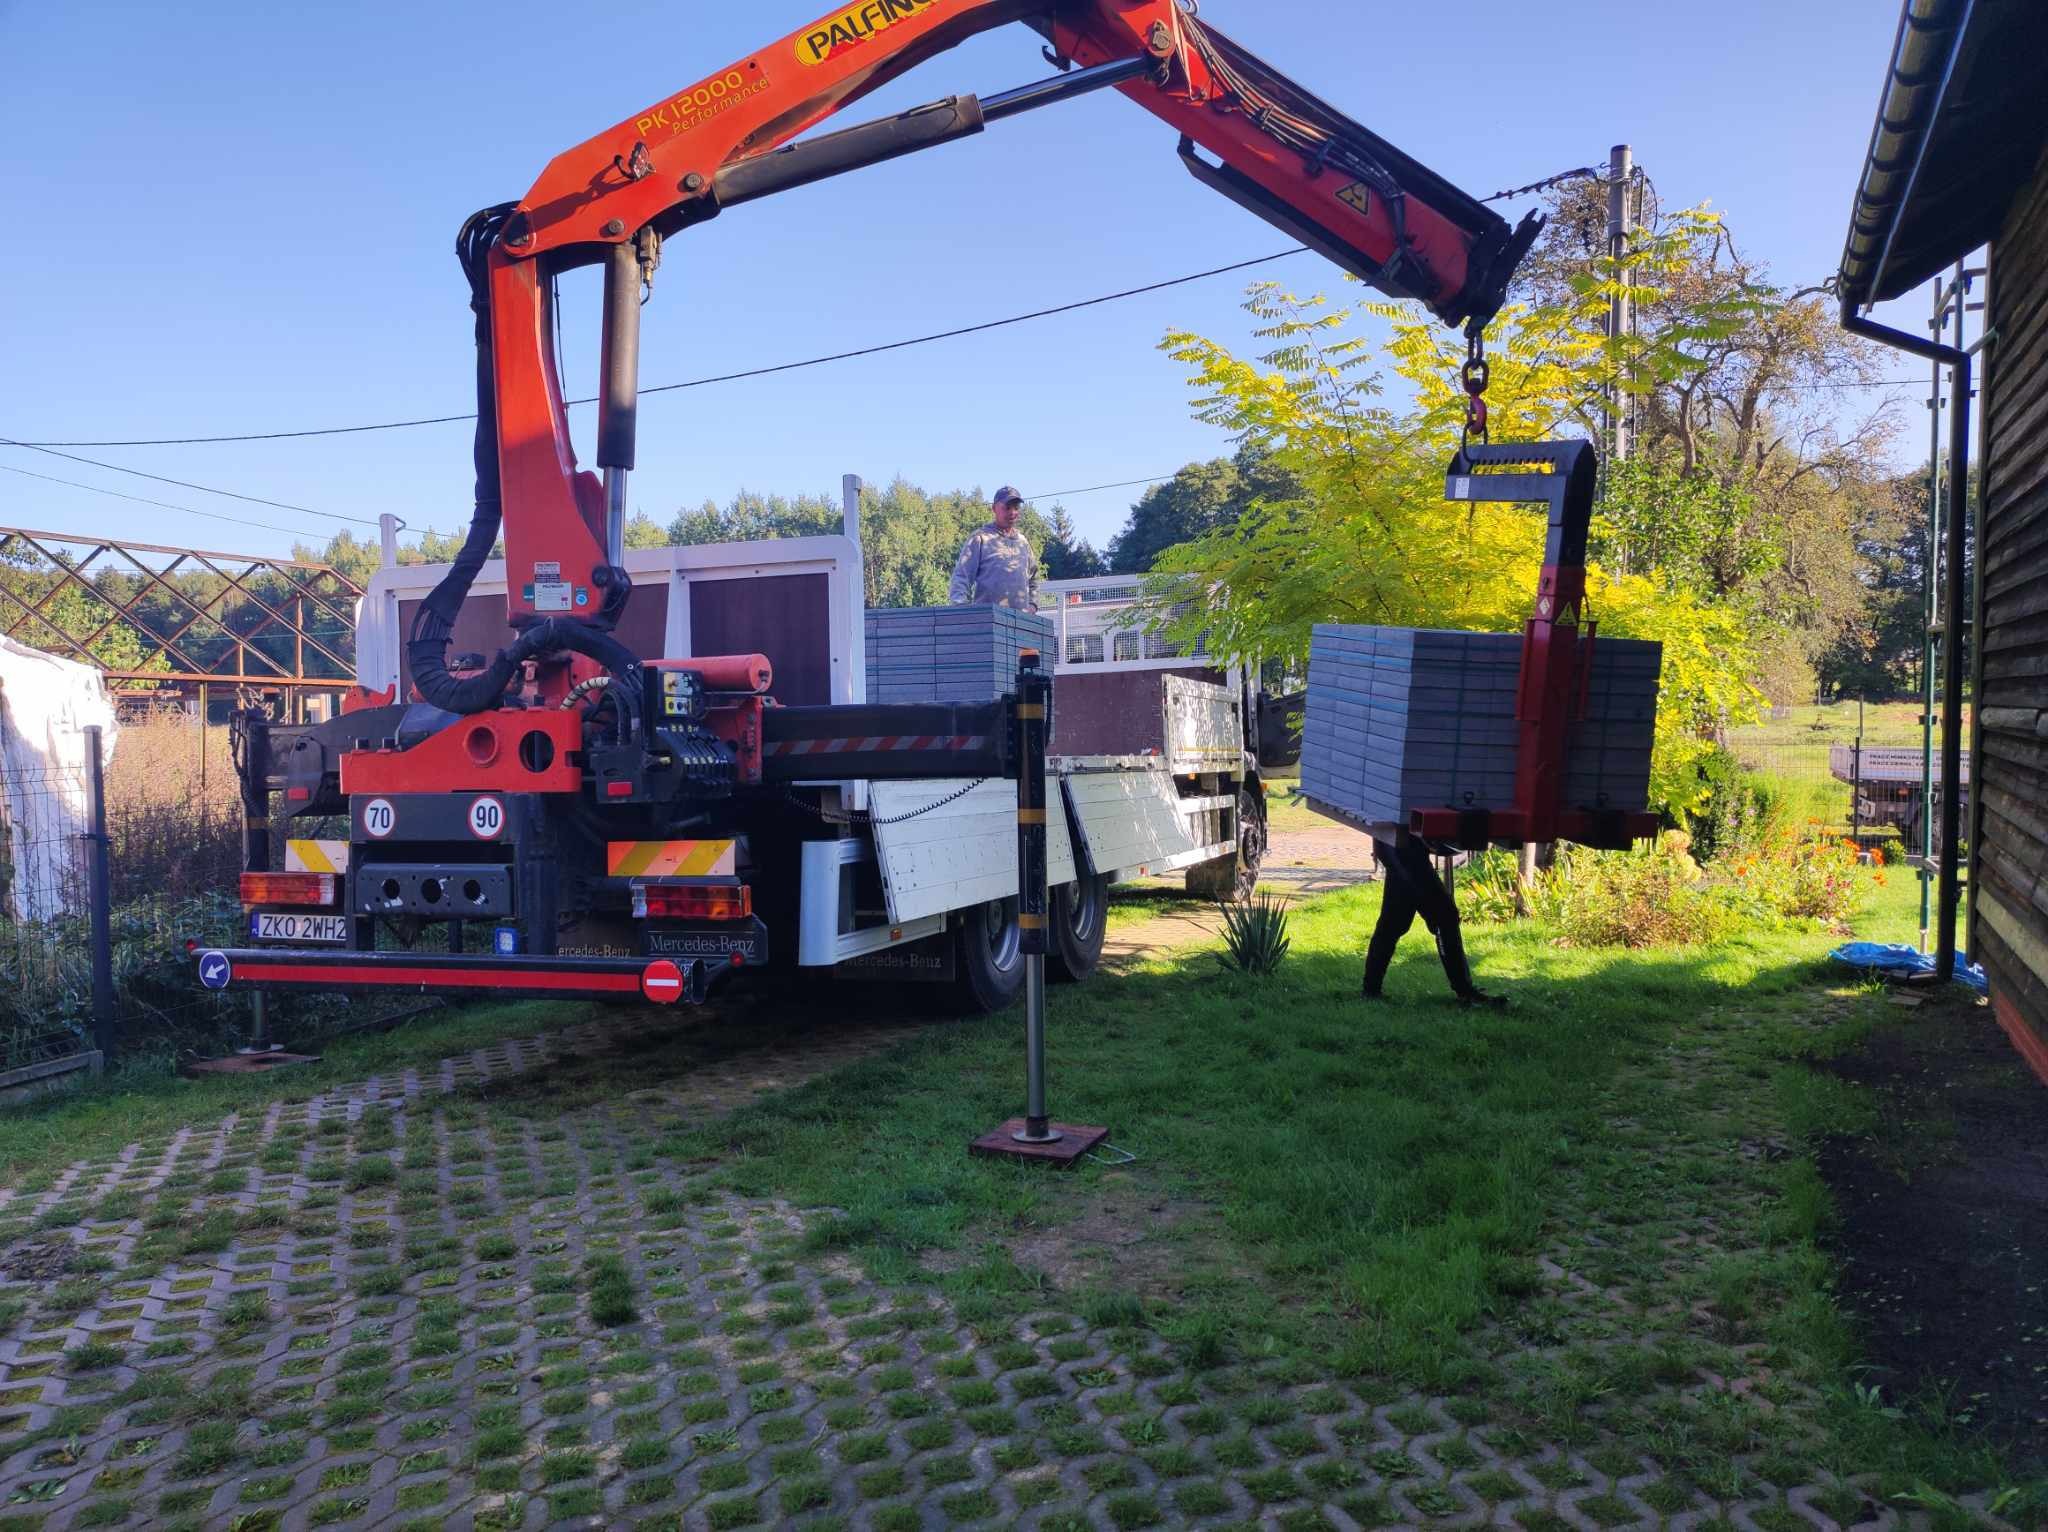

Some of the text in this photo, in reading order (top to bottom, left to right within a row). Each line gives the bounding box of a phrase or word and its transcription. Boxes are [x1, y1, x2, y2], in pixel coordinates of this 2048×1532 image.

[806, 0, 940, 60] PALFIN
[636, 71, 743, 137] PK 12000
[672, 78, 769, 136] Performance
[370, 807, 390, 828] 70
[476, 805, 499, 828] 90
[262, 916, 296, 937] ZKO
[557, 943, 631, 959] ercedes-Benz
[650, 935, 755, 953] Mercedes-Benz
